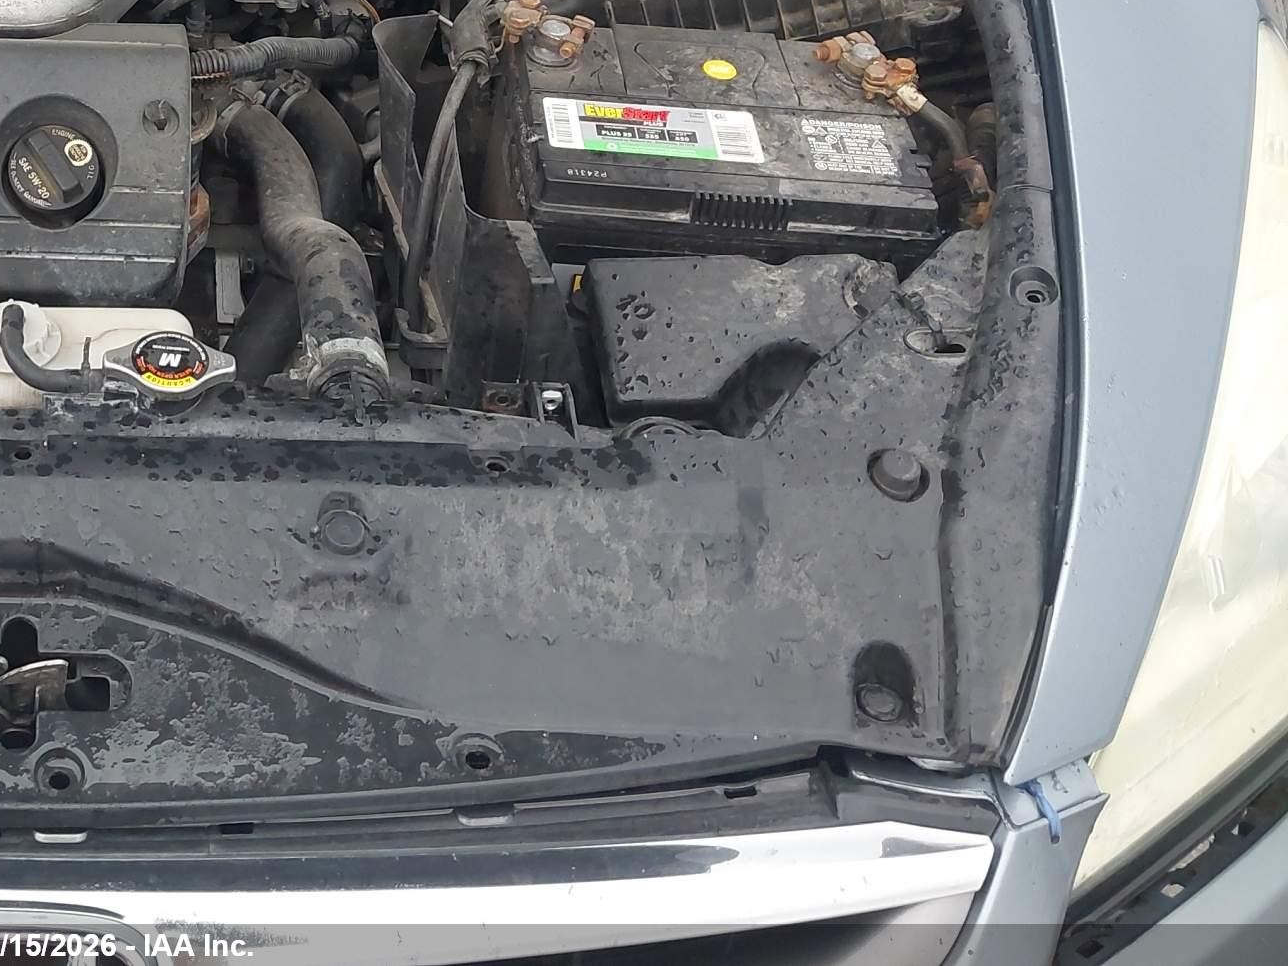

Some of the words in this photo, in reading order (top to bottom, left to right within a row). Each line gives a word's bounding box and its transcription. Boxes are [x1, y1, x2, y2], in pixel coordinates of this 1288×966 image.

[583, 102, 671, 122] EverStart
[52, 129, 77, 140] ENGINE
[18, 157, 33, 173] SAE
[28, 171, 50, 199] 5W-20
[87, 164, 95, 179] OIL
[159, 352, 182, 368] M
